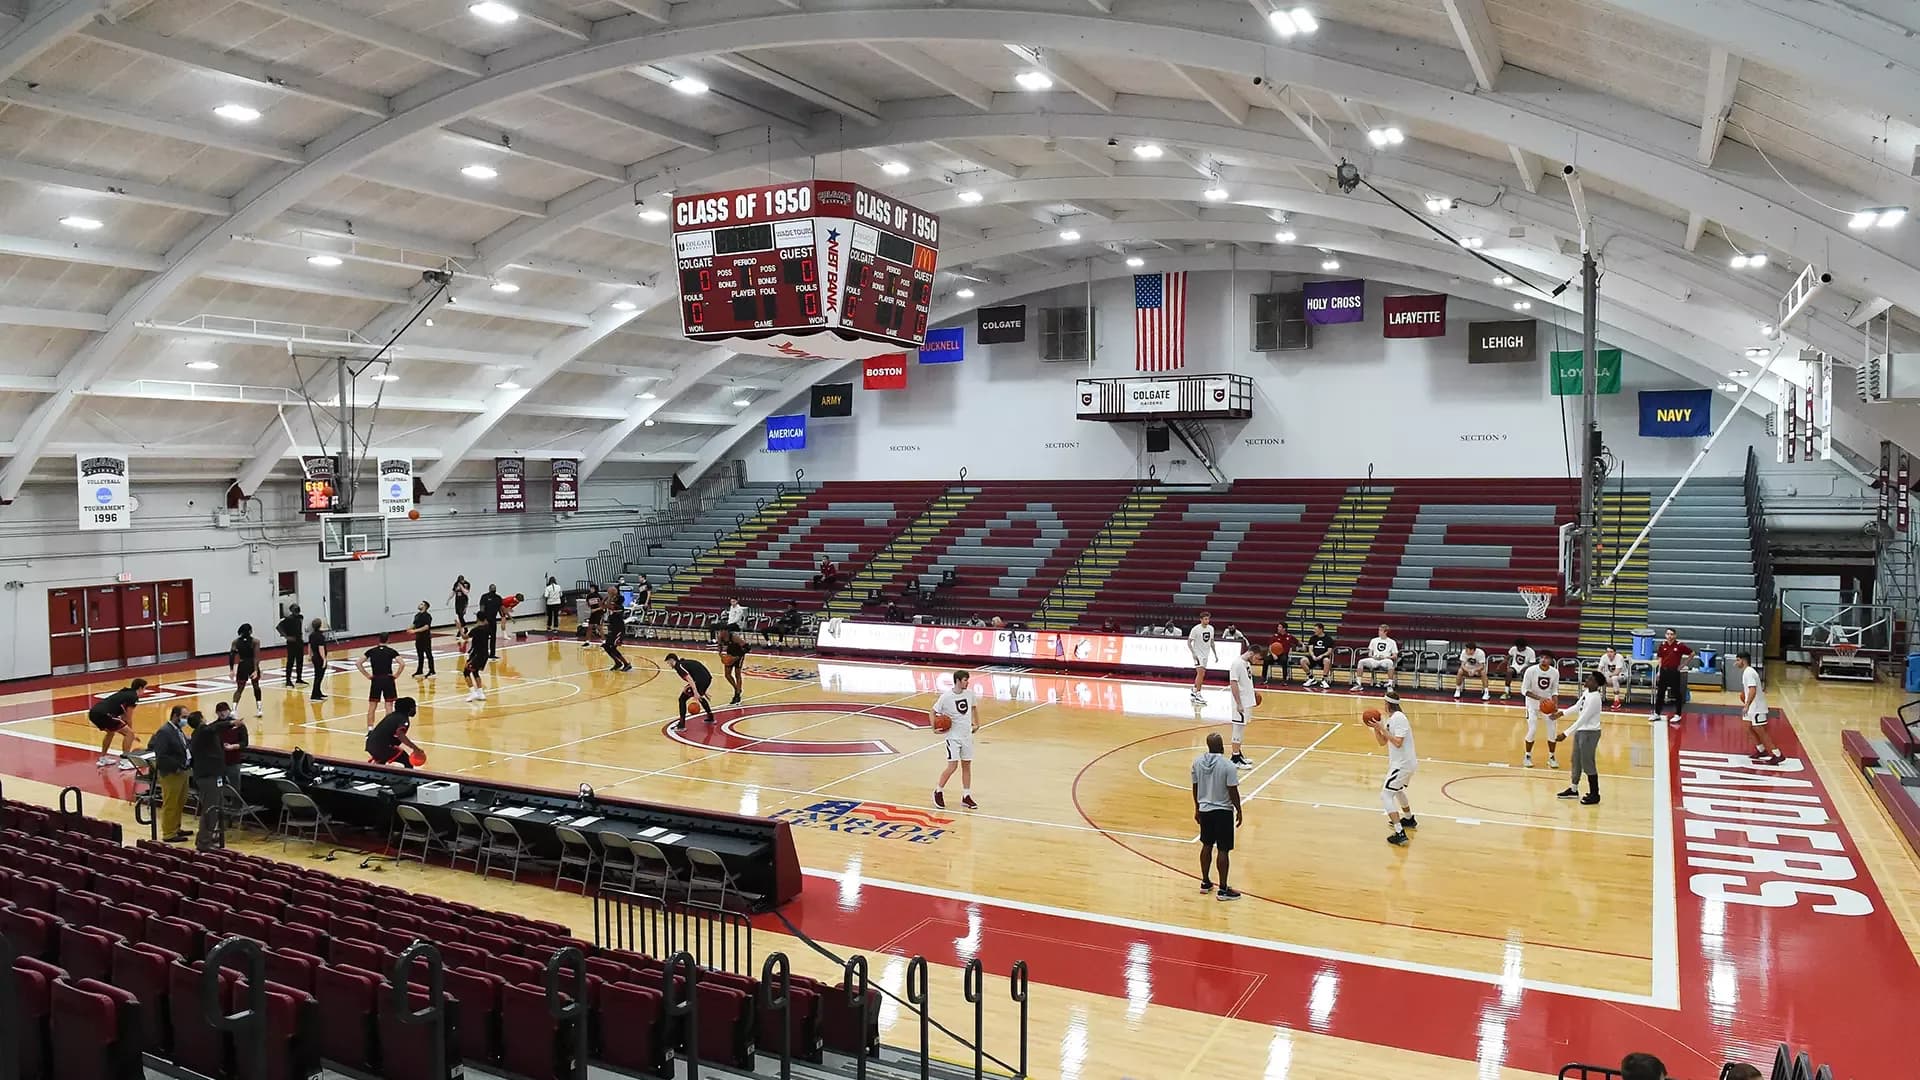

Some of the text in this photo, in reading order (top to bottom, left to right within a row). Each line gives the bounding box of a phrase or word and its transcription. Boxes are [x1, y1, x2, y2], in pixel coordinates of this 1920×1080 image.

[677, 187, 811, 226] CLASS OF 1950
[856, 191, 937, 242] CLASS OF 1950
[780, 247, 814, 260] GUEST
[850, 250, 875, 266] COLGATE
[679, 257, 713, 270] COLGATE
[733, 258, 757, 266] PERIOD
[717, 269, 732, 277] POSS
[760, 265, 776, 273] POSS
[802, 260, 813, 282] 0
[873, 270, 884, 279] POSS
[887, 265, 901, 275] PERIOD
[700, 270, 711, 291] 0
[757, 277, 777, 285] BONUS
[827, 240, 839, 313] NBT BANK
[861, 265, 869, 288] 0
[914, 269, 932, 284] GUEST
[718, 280, 737, 289] BONUS
[796, 284, 817, 293] FOULS
[872, 282, 885, 292] BONUS
[731, 288, 776, 298] PLAYER FOUL
[846, 286, 861, 296] FOULS
[684, 293, 703, 301] FOULS
[879, 294, 906, 307] PLAYER FOUL
[804, 293, 816, 315] 0
[848, 296, 856, 318] 0
[916, 304, 928, 313] FOULS
[1307, 296, 1361, 310] HOLY CROSS
[692, 302, 703, 323] 0
[1389, 311, 1440, 325] LAFAYETTE
[754, 320, 773, 328] GAME
[809, 316, 825, 324] WON
[842, 318, 853, 327] WON
[982, 320, 1022, 330] COLGATE
[688, 325, 704, 333] WON
[886, 328, 898, 337] GAME
[913, 334, 923, 342] WON
[1482, 336, 1524, 348] LEHIGH
[920, 339, 960, 351] BUCKNELL
[866, 367, 903, 377] BOSTON
[1560, 367, 1610, 378] LOYLA
[821, 395, 842, 406] ARMY
[1133, 390, 1170, 400] COLGATE
[1657, 409, 1692, 422] NAVY
[768, 427, 804, 439] AMERICAN
[84, 504, 125, 512] TOURNAMENT
[94, 513, 117, 523] 1996
[973, 632, 983, 645] 0
[662, 701, 935, 756] C
[768, 808, 955, 837] PATRIOT
[789, 818, 938, 844] LEAGUE
[1678, 749, 1875, 917] RAIDERS
